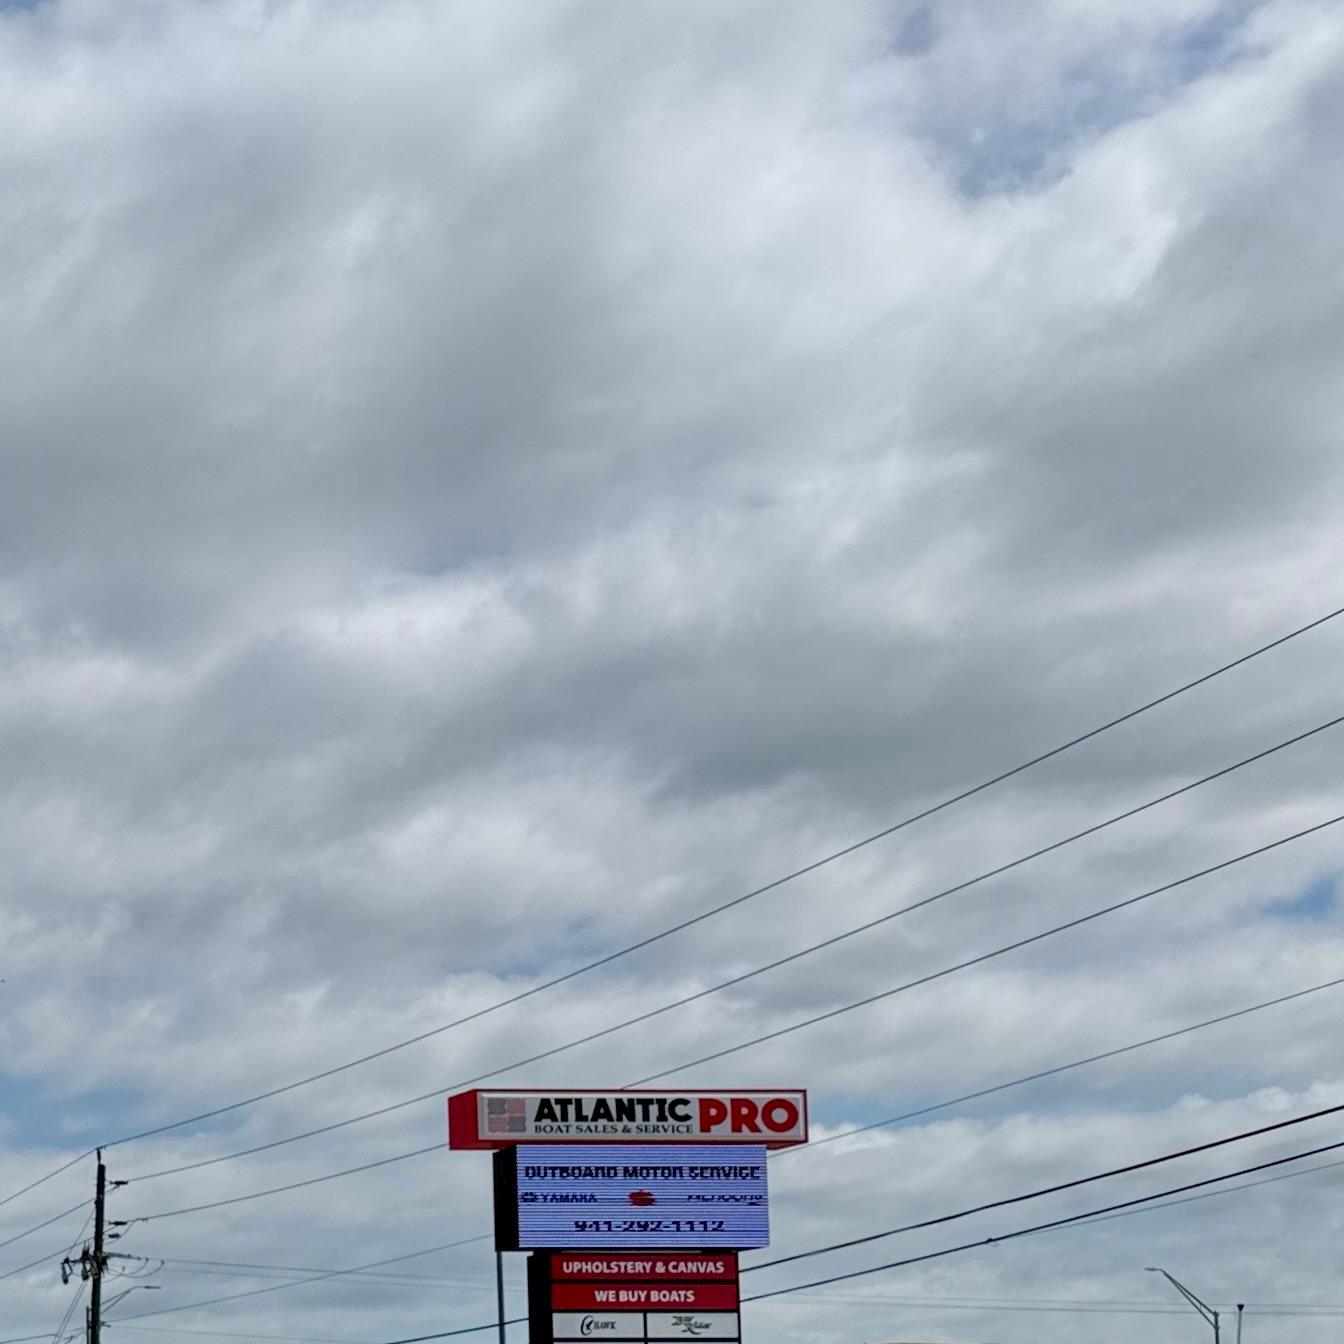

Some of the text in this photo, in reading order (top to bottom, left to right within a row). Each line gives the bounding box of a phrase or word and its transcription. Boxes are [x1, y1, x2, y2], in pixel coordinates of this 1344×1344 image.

[534, 1097, 799, 1134] ATLANTIC PRO
[534, 1124, 694, 1135] BOAT SALES & SERVICE
[562, 1261, 725, 1274] UPHOLSTERY & CANVAS
[594, 1290, 695, 1303] WE BUY BOATS
